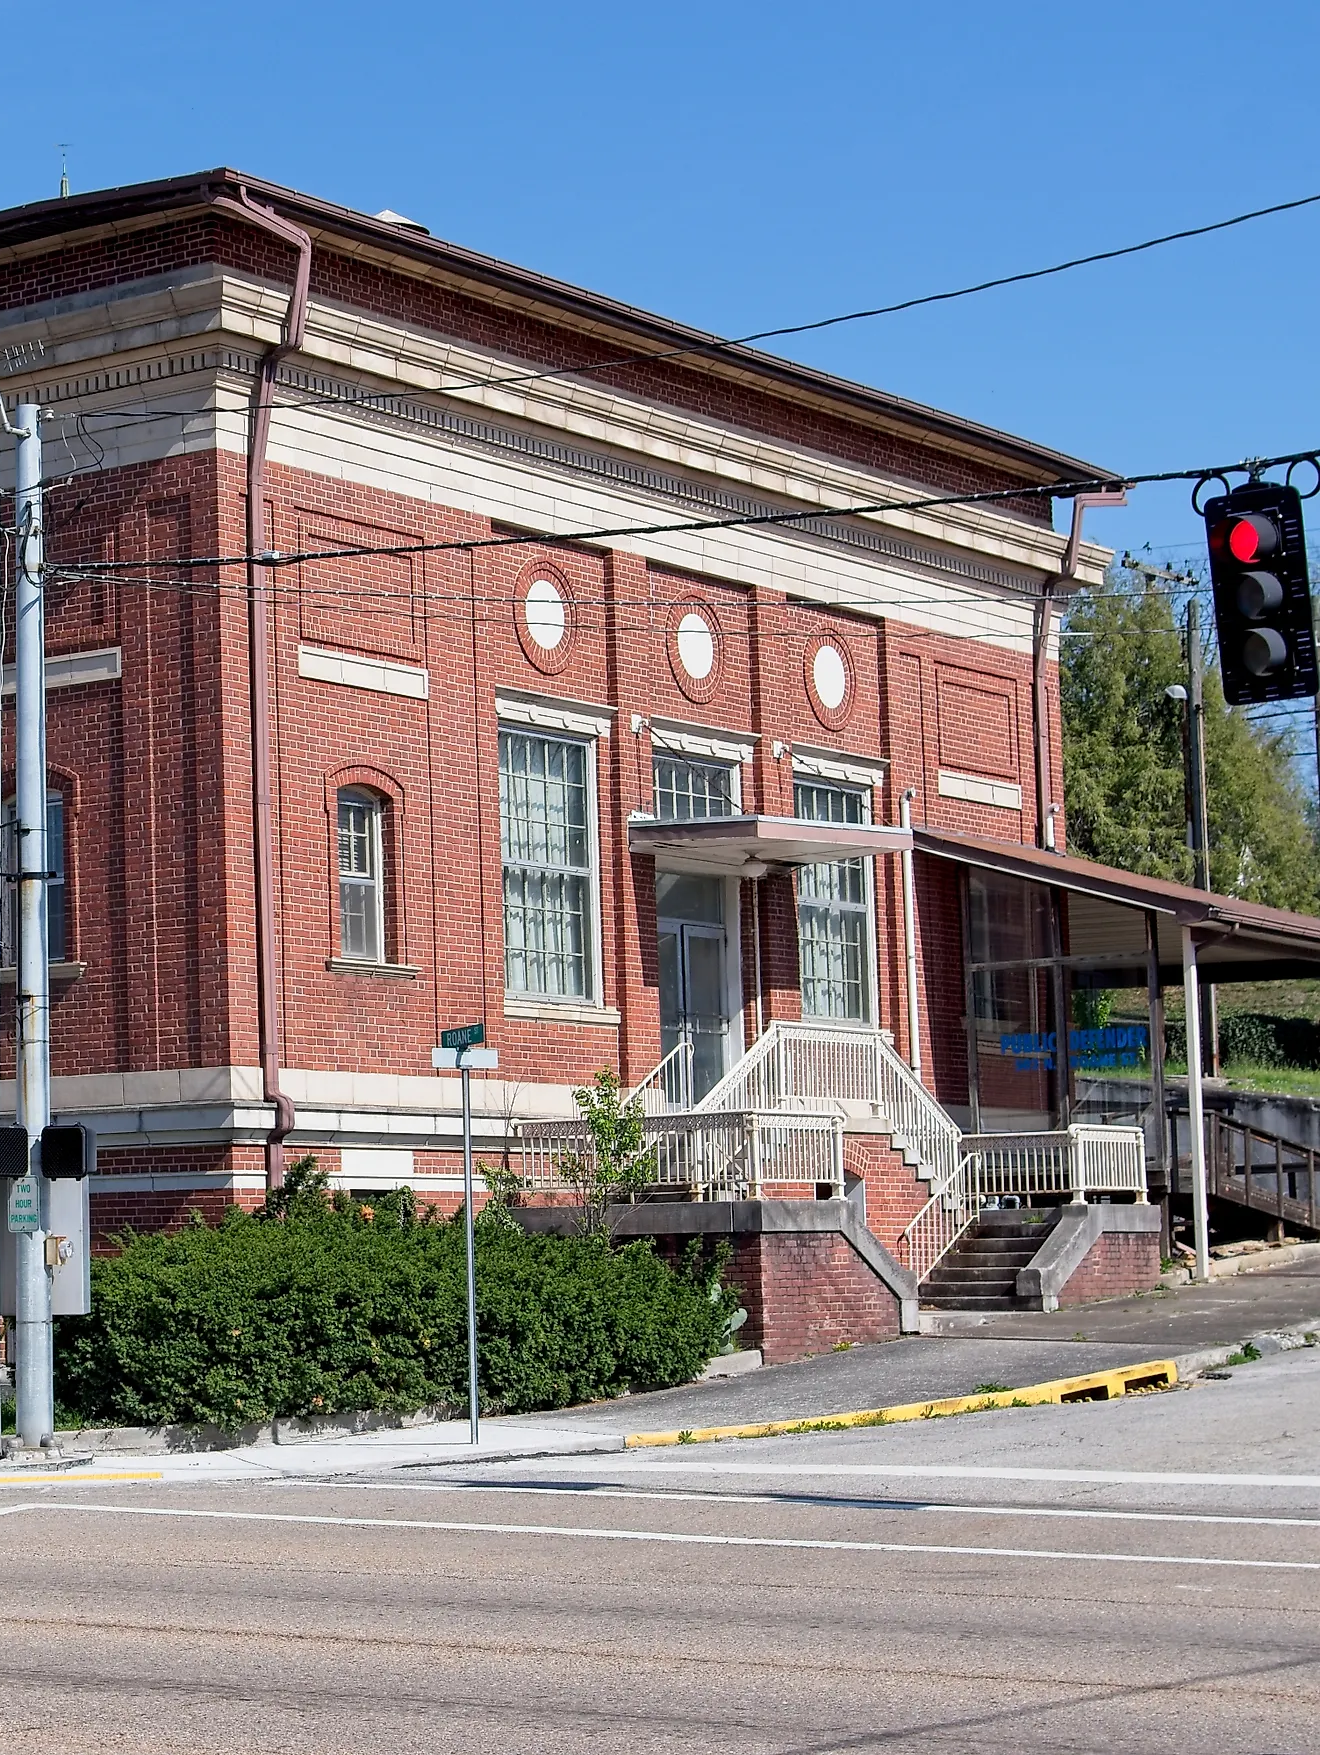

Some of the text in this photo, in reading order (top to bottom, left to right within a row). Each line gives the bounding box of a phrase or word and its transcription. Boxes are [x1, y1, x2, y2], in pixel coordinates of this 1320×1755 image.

[446, 1029, 472, 1047] ROANE
[1000, 1026, 1148, 1055] PUBLIC DEFENDER
[16, 1184, 31, 1193] TWO
[15, 1199, 32, 1208] HOUR
[10, 1214, 37, 1223] PARKING
